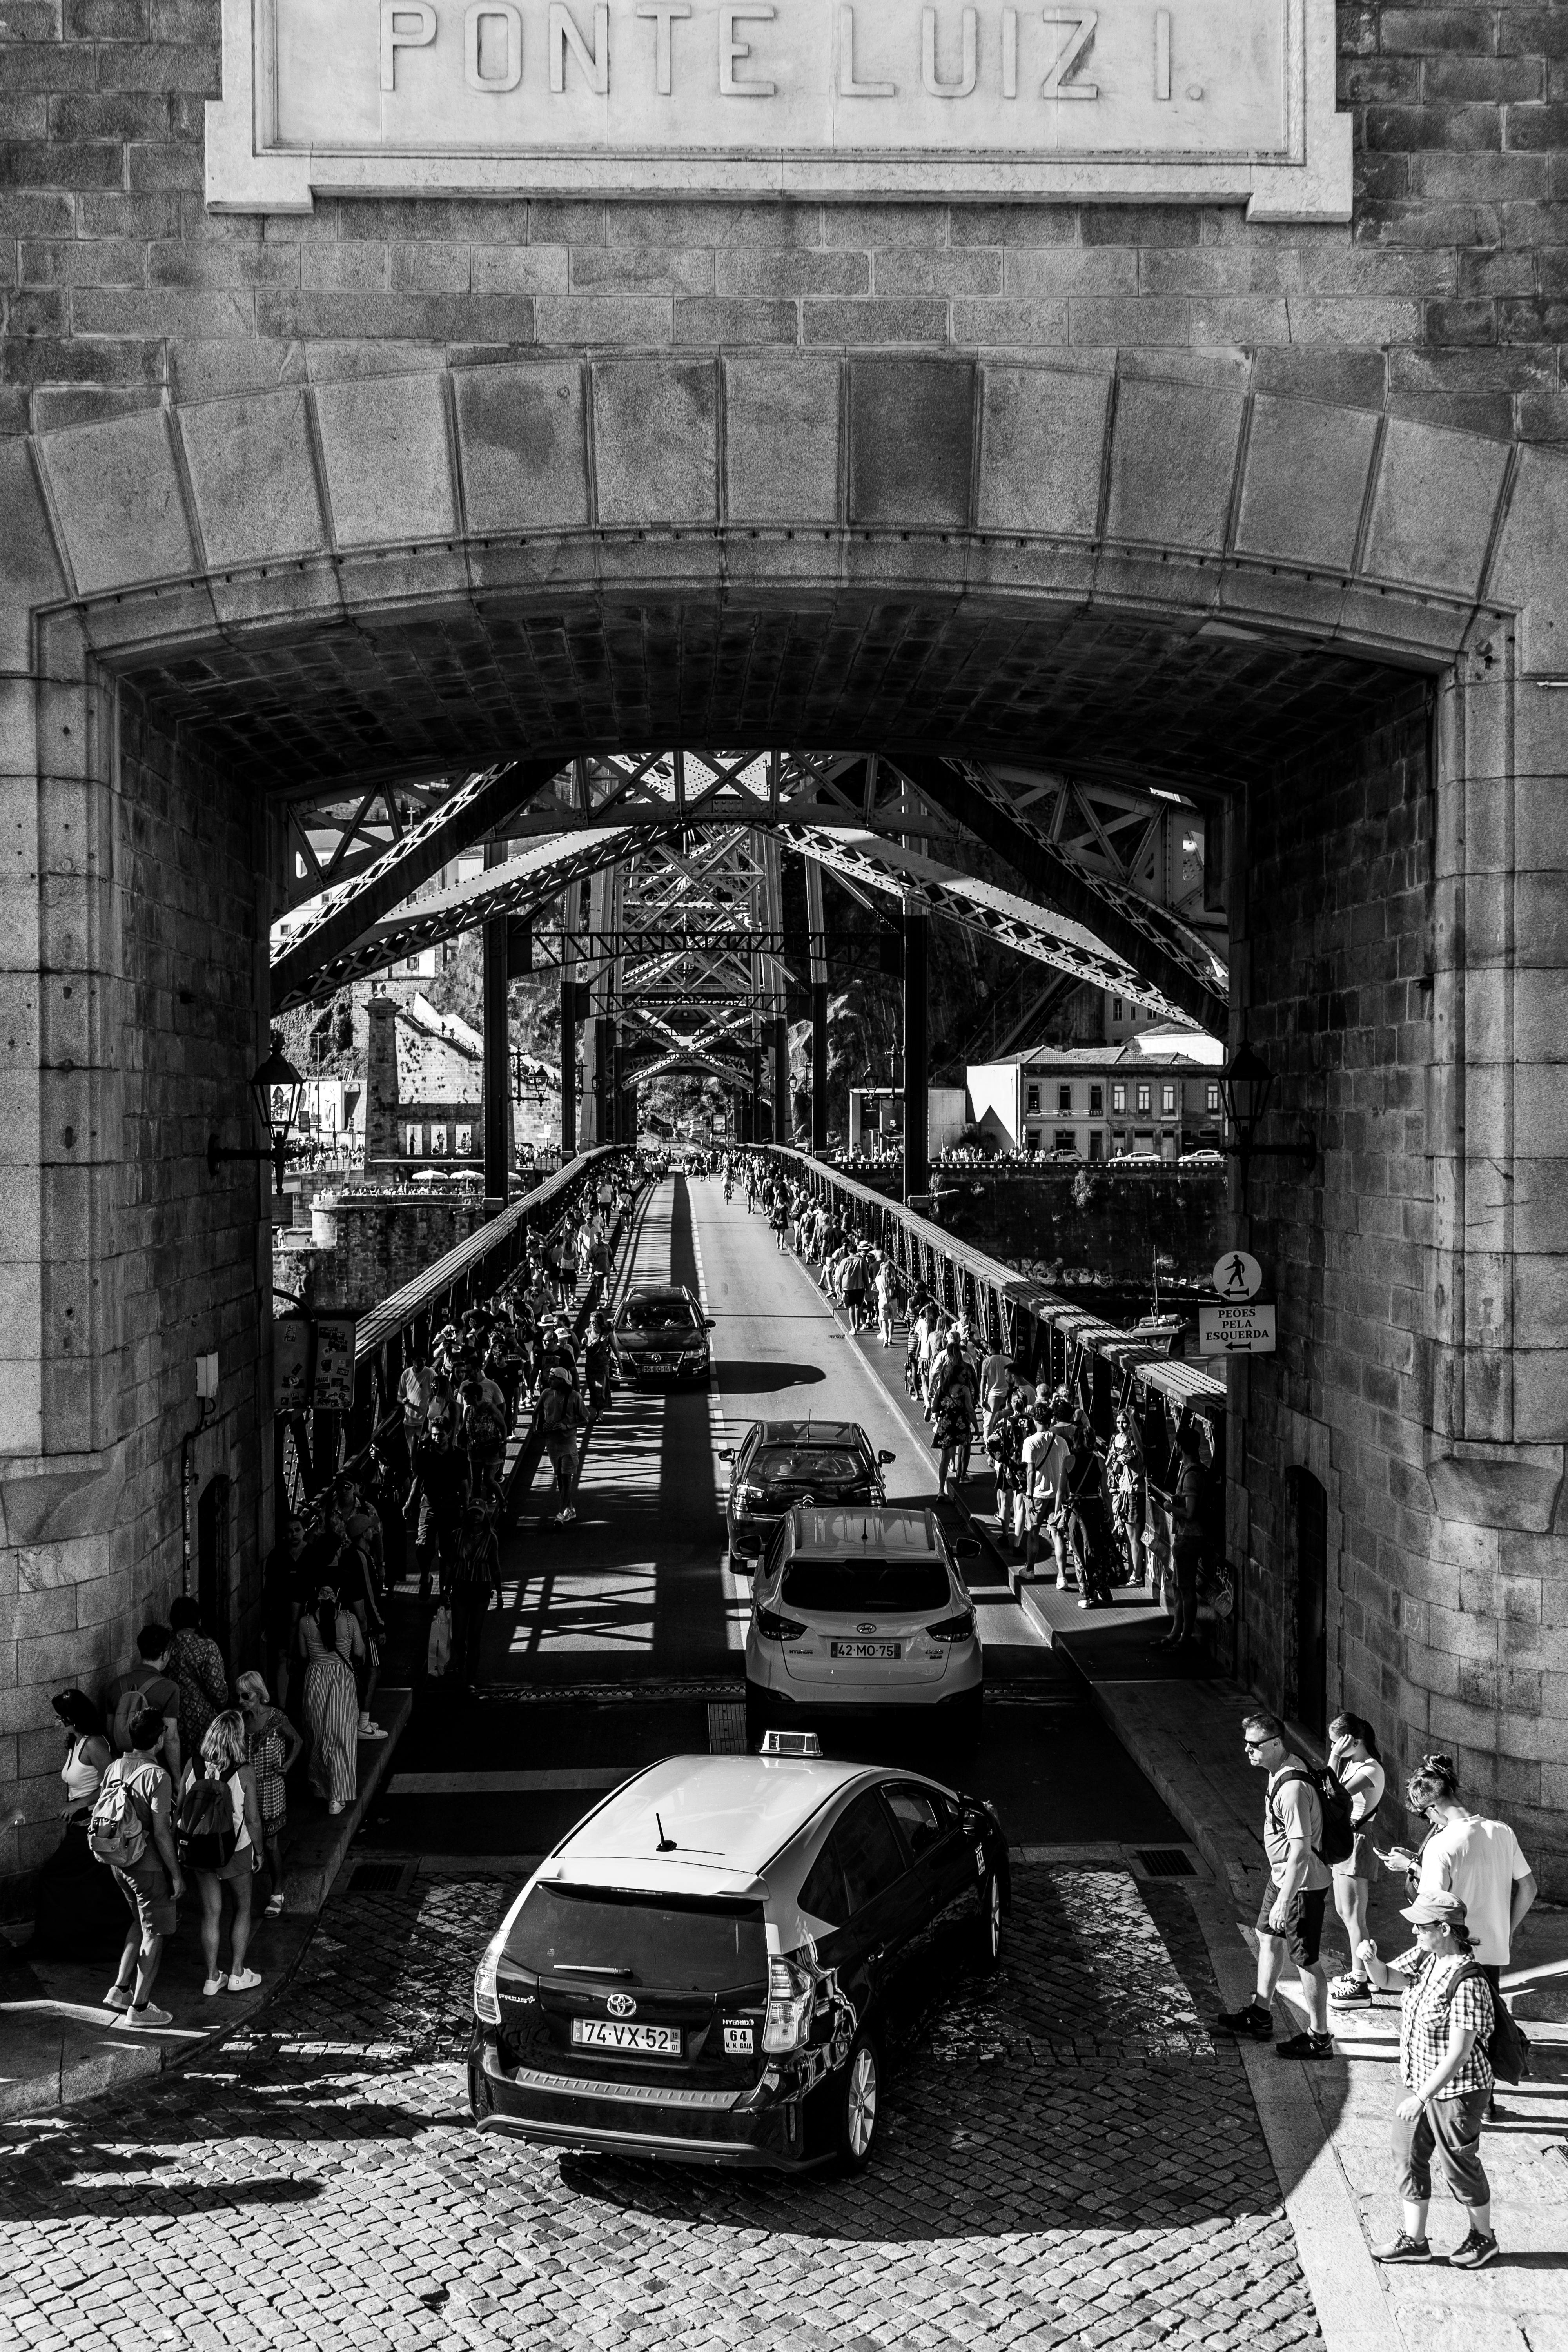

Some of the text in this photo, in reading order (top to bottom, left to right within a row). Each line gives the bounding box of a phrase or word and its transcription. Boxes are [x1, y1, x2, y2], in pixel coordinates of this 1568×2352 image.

[380, 0, 775, 96] PONTE
[840, 5, 1099, 100] LUIZ
[1218, 1307, 1256, 1318] PEÕES
[1222, 1319, 1253, 1329] PELA
[1205, 1329, 1270, 1341] ESQUERDA
[730, 2030, 747, 2042] 64
